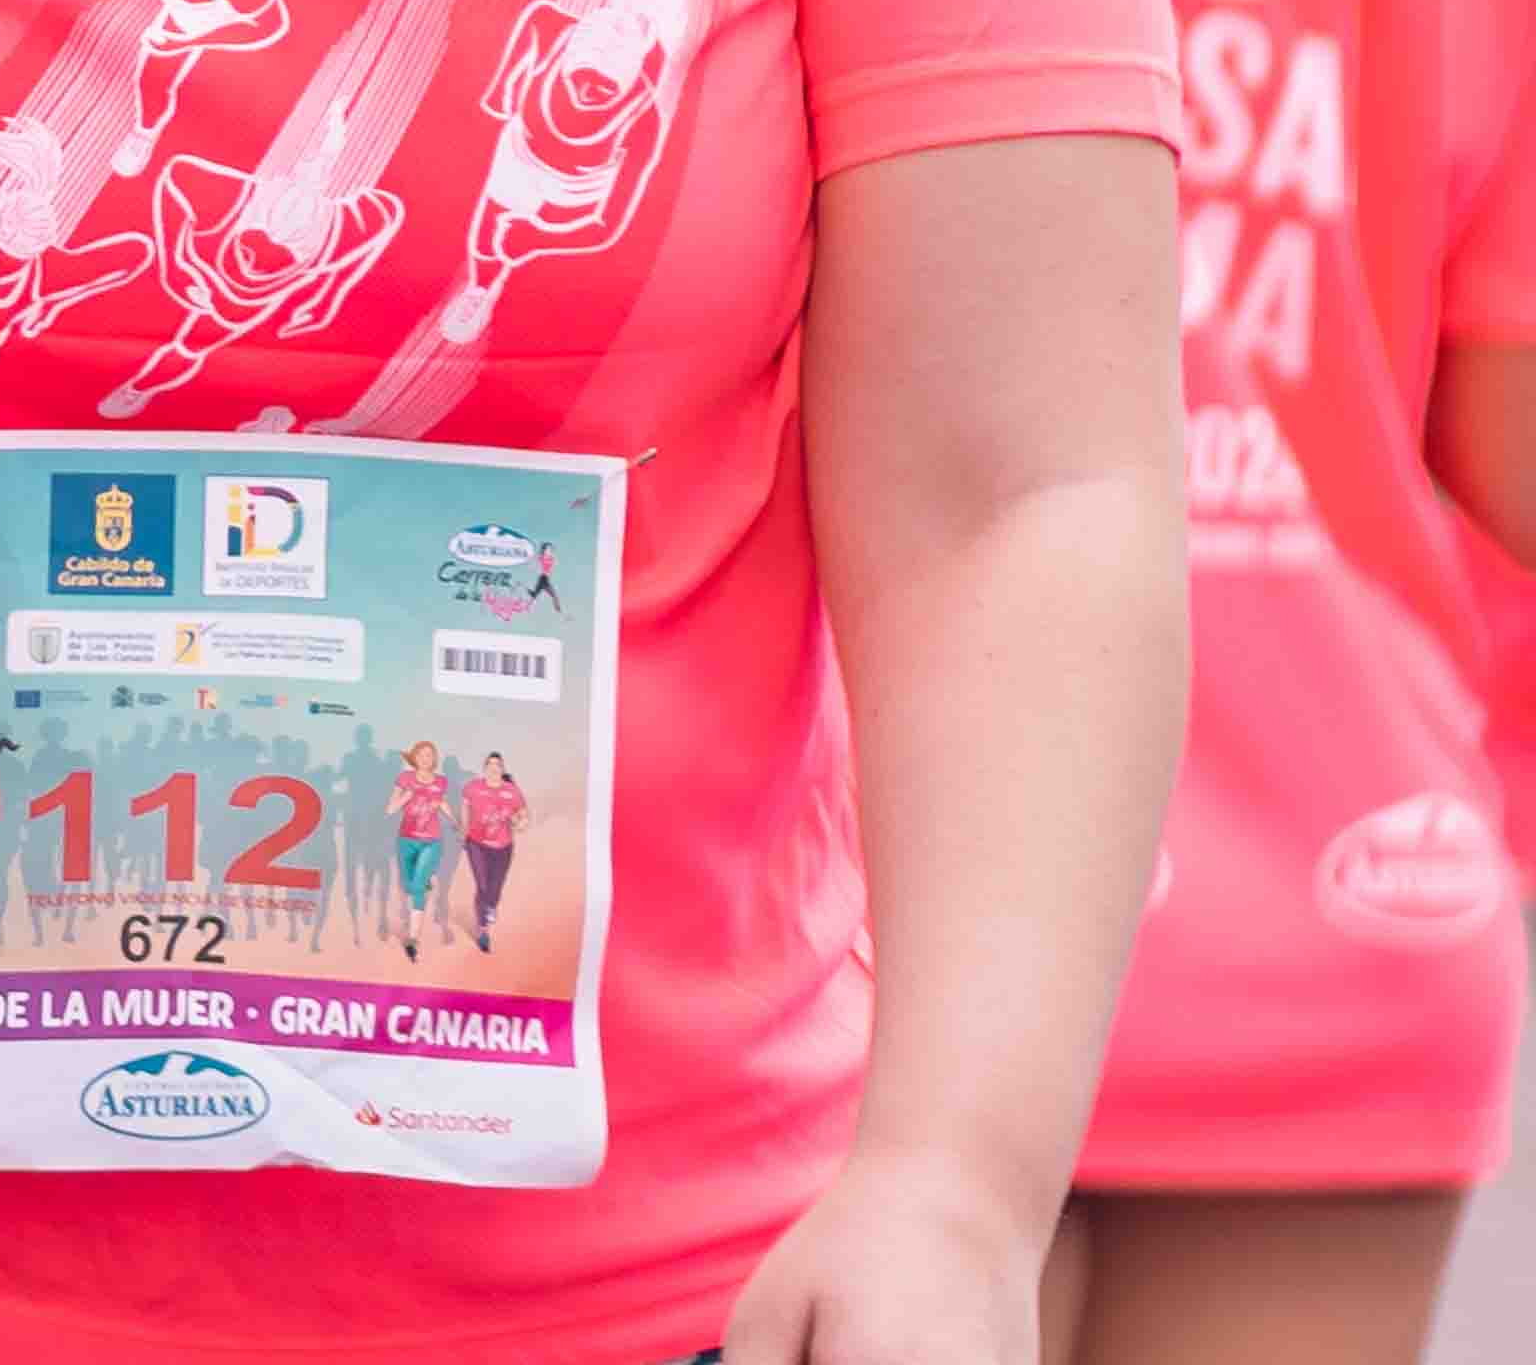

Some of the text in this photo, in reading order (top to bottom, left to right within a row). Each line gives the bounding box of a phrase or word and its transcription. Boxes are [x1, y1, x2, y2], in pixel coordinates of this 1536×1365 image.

[57, 570, 166, 588] Gran Canaria
[29, 771, 323, 891] 112
[119, 914, 228, 964] 672
[41, 989, 94, 1029] LA
[101, 988, 235, 1030] MUJER
[270, 995, 377, 1040] GRAN
[387, 1005, 550, 1055] CANARIA
[95, 1084, 256, 1118] ASTURIANA
[387, 1106, 514, 1135] Santander
